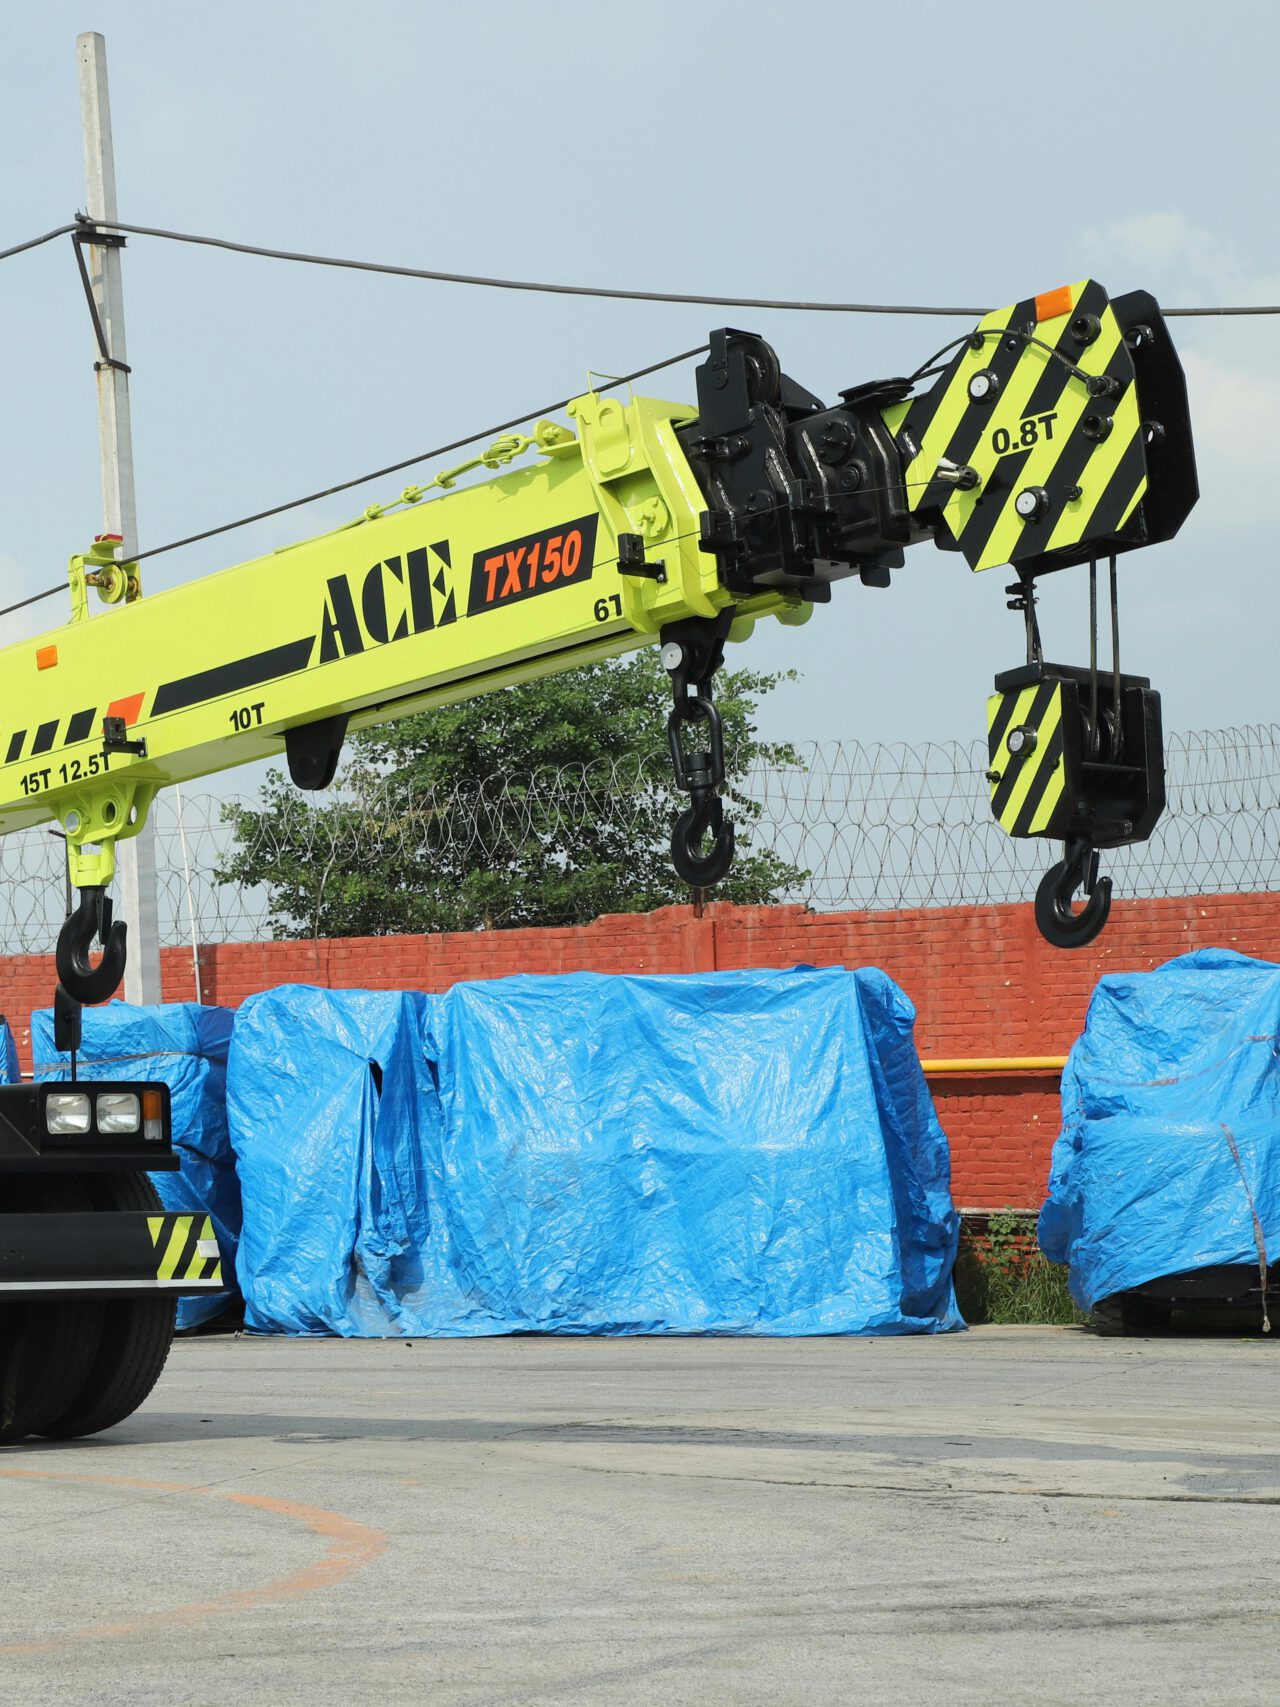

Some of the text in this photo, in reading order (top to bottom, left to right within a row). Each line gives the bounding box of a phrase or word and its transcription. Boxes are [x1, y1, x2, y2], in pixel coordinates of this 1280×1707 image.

[991, 412, 1058, 455] 0.8T
[320, 529, 583, 664] ACE TX150
[229, 702, 266, 732] 10T
[20, 751, 111, 795] 15T 12.5T
